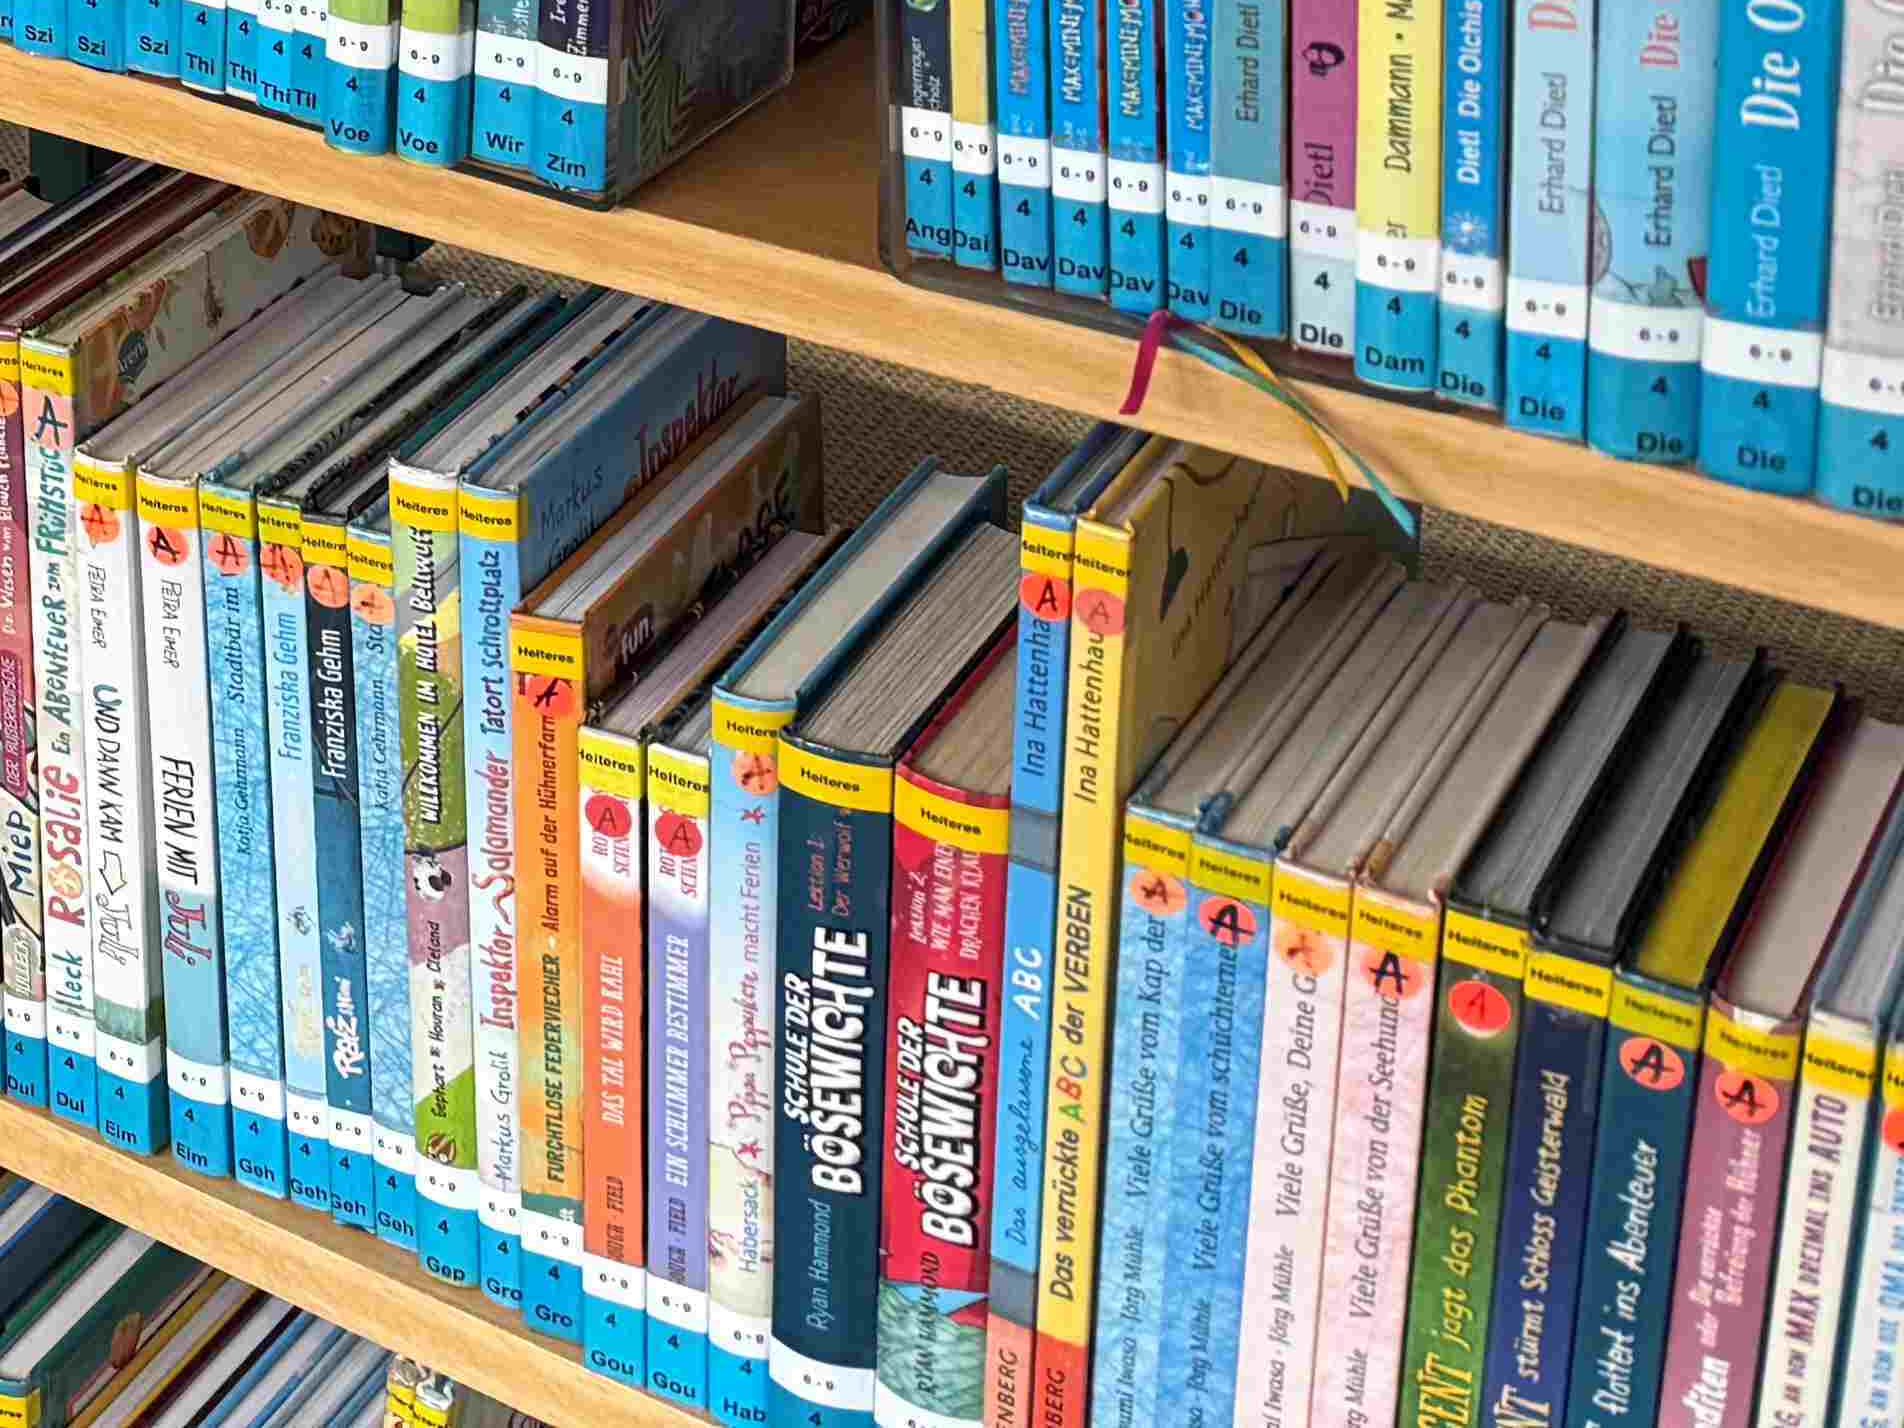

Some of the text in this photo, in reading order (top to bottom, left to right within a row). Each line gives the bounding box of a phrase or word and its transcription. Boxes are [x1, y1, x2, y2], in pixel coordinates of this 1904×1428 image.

[329, 117, 372, 146] Voe
[479, 926, 517, 1031] Inspektor
[1063, 884, 1094, 995] VERBEN
[599, 953, 625, 1127] DAS TAL WIRD KAHL
[783, 973, 811, 1124] SCHULE DER
[802, 925, 875, 1196] BÖSEWICHTE
